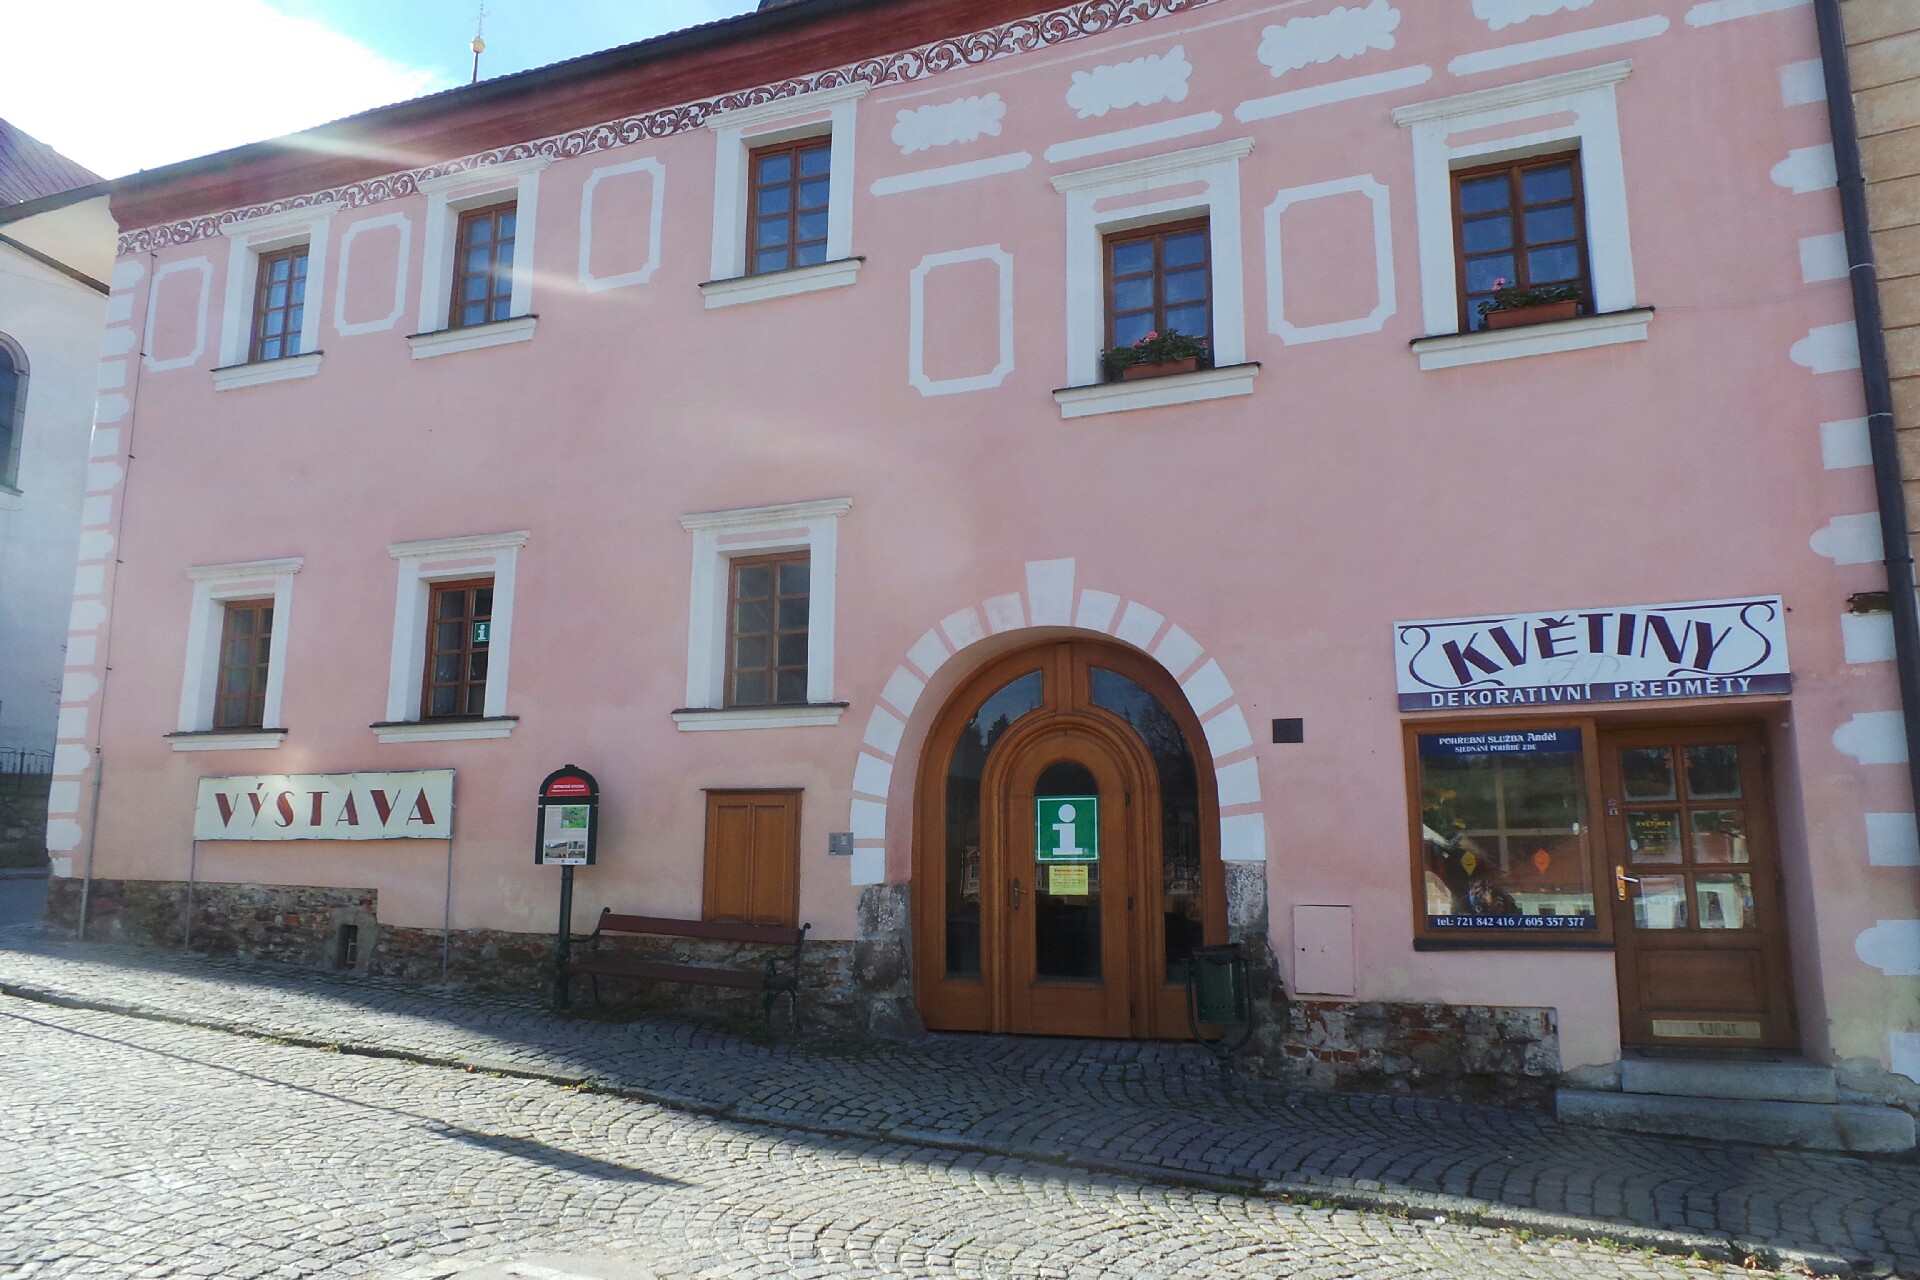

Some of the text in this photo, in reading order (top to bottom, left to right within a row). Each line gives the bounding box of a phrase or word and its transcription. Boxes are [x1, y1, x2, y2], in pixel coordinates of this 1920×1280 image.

[1442, 612, 1733, 686] KVĚTINY
[1431, 677, 1752, 707] DEKORATIVNÍ PŘEDMĚTY
[1439, 732, 1557, 745] POHŘEBNÍ SLUŽBA Anděl
[1455, 744, 1488, 753] SJEDNÁNÍ
[1522, 743, 1537, 751] ZDE
[215, 782, 435, 829] VÝSTAVA
[1457, 917, 1473, 927] 721
[1476, 917, 1494, 927] 842
[1496, 917, 1515, 927] 416
[1525, 917, 1544, 927] 605
[1546, 917, 1564, 927] 357
[1567, 917, 1585, 927] 377
